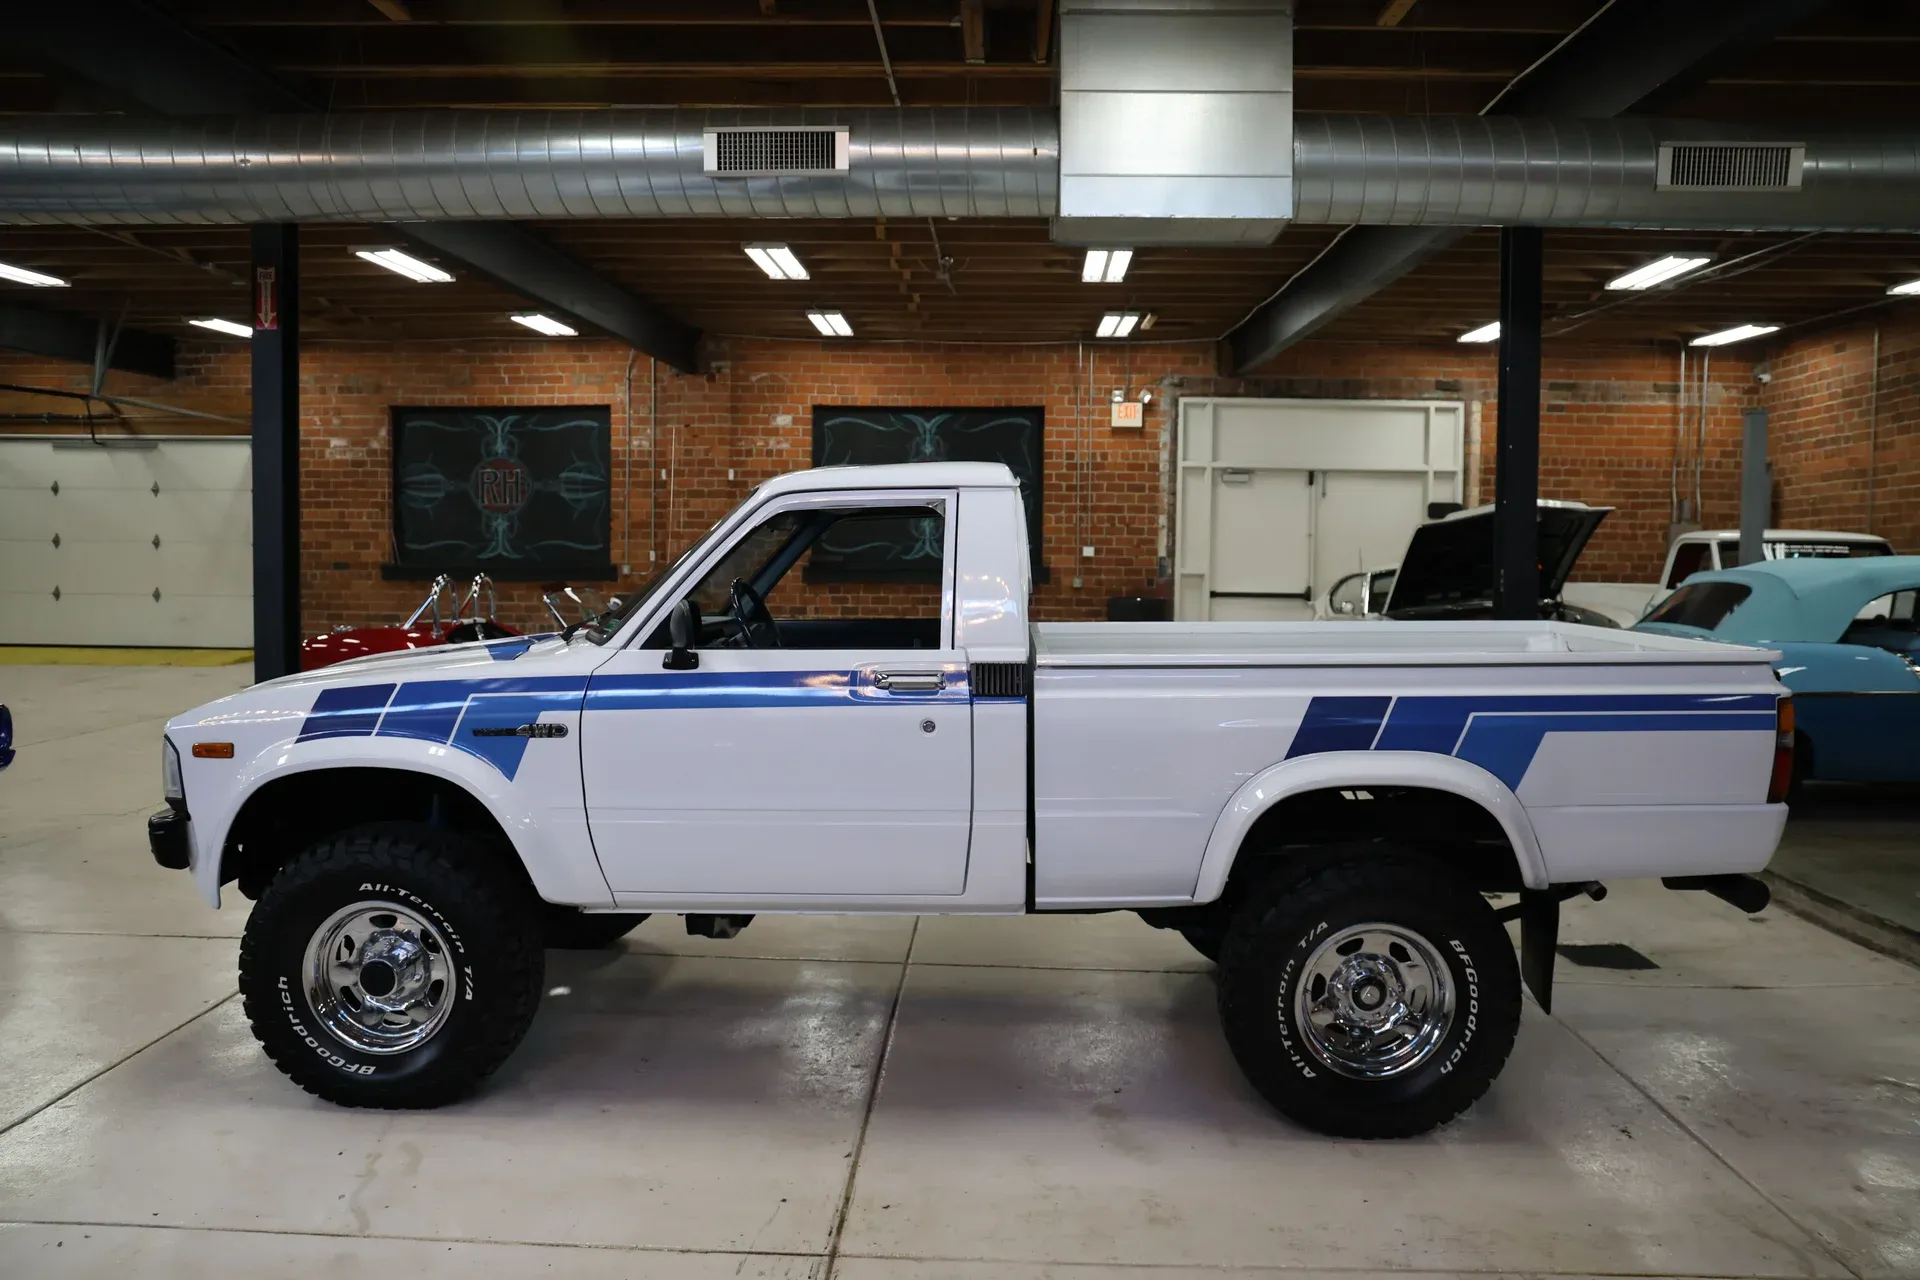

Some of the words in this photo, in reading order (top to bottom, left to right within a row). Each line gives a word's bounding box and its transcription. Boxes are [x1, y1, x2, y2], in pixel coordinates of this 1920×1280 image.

[1118, 404, 1137, 419] EXIT
[479, 469, 523, 505] RH
[516, 724, 568, 738] 4WD
[358, 882, 465, 954] All-Terrain
[464, 965, 474, 1001] T/A
[277, 976, 377, 1076] BFGoodrich
[1274, 958, 1317, 1079] All-Terrain
[1297, 921, 1329, 949] T/A
[1440, 939, 1478, 1075] BFGoodrich
